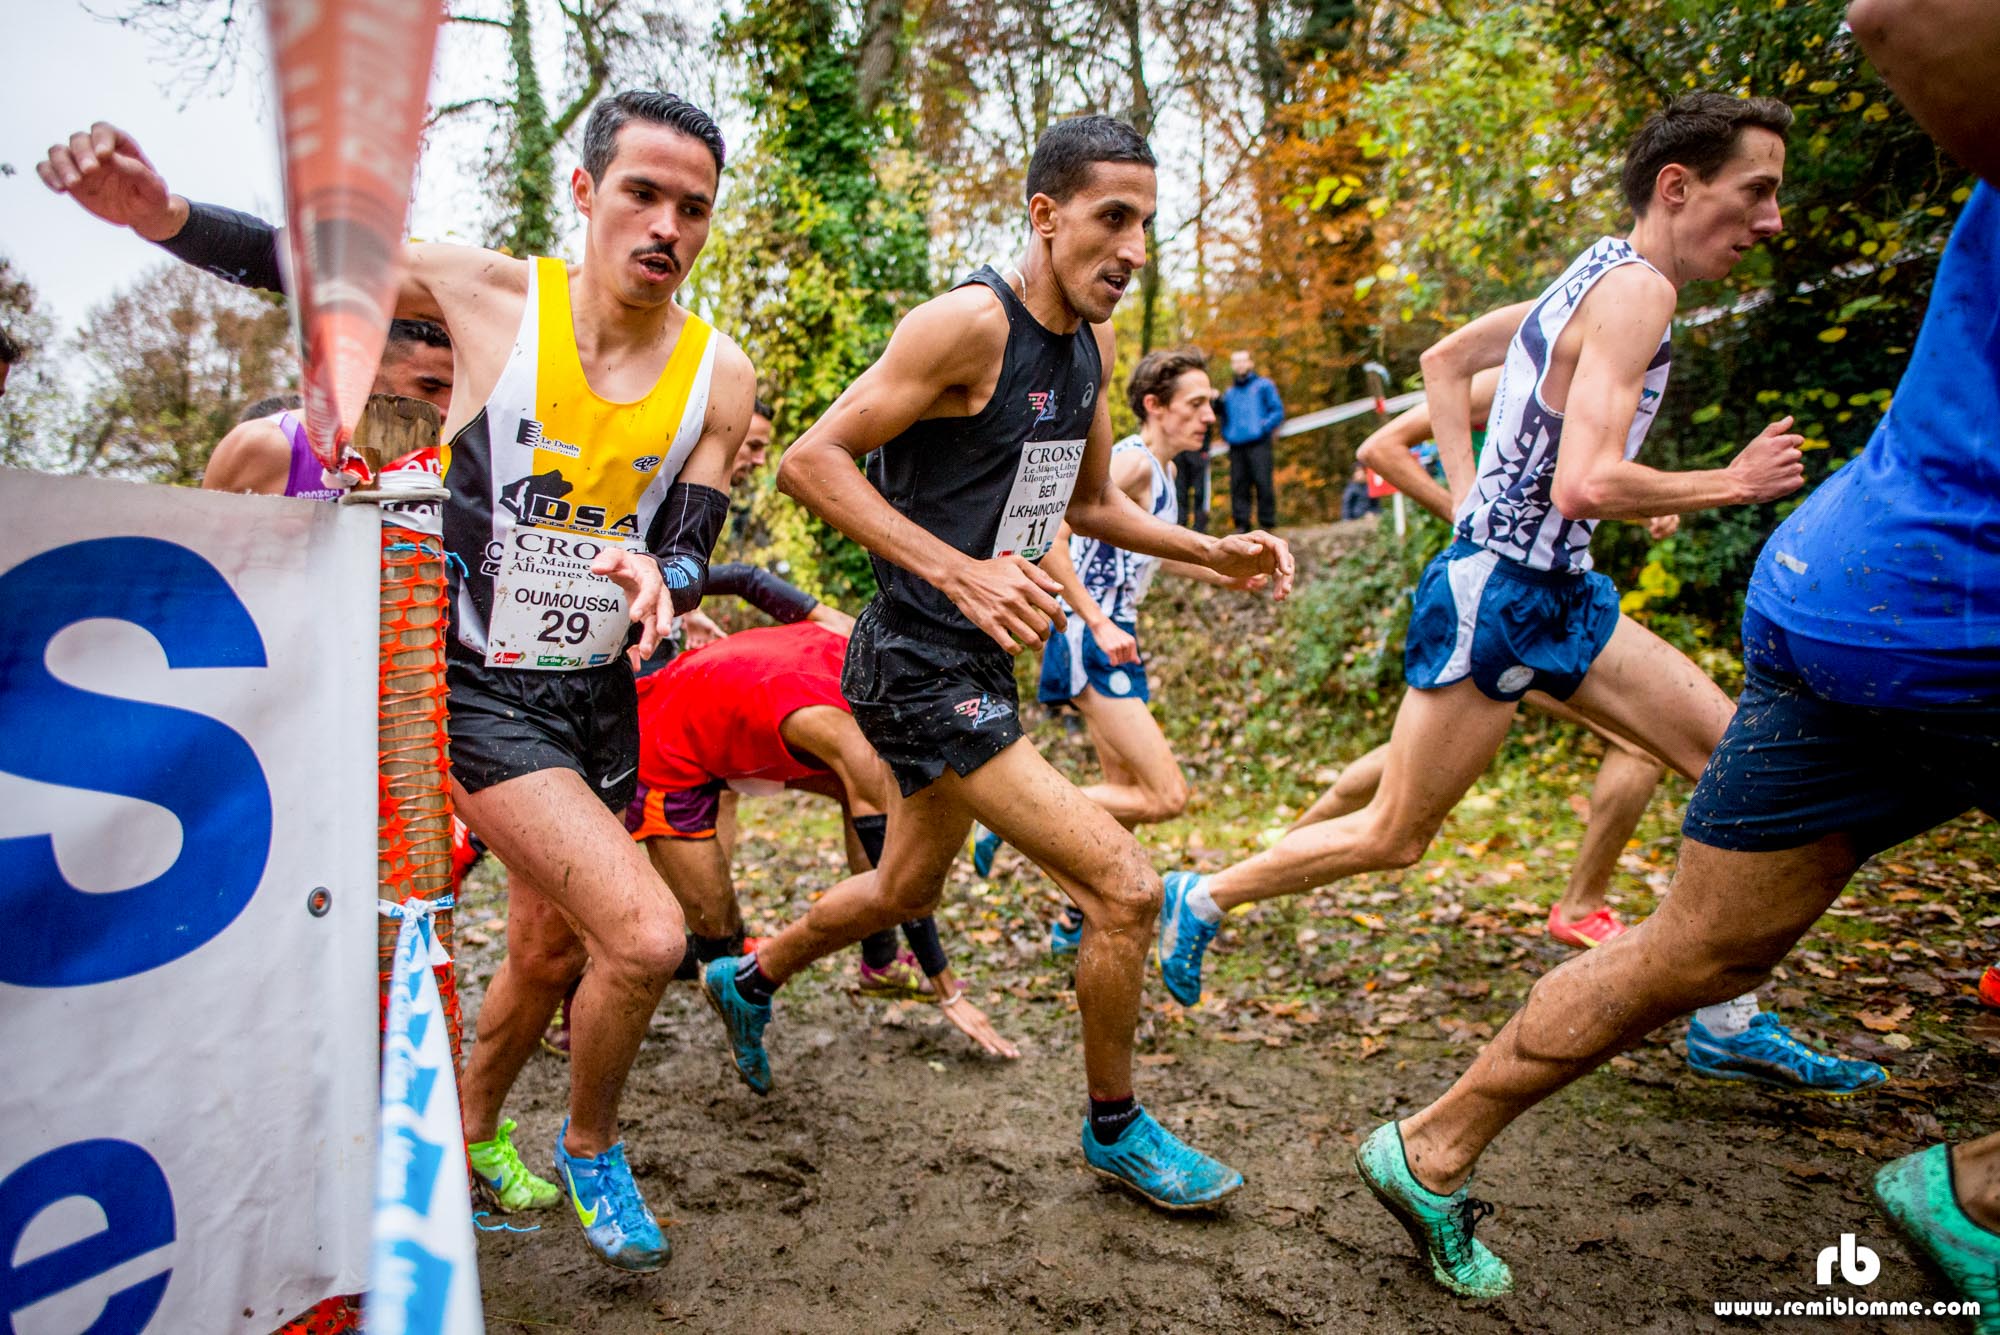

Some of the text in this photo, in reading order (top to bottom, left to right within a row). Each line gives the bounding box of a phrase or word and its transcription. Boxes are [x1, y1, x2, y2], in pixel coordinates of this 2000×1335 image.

[541, 437, 552, 445] Le
[554, 440, 580, 452] Doubs
[1028, 446, 1082, 464] CROSS
[1024, 466, 1035, 474] Le
[1039, 484, 1057, 498] BEN
[531, 494, 639, 533] DSA
[568, 524, 590, 532] Sud
[1027, 518, 1048, 546] 11
[511, 562, 583, 579] Allonnes
[514, 552, 590, 571] Le Maine
[515, 588, 620, 612] OUMOUSSA
[537, 609, 590, 644] 29
